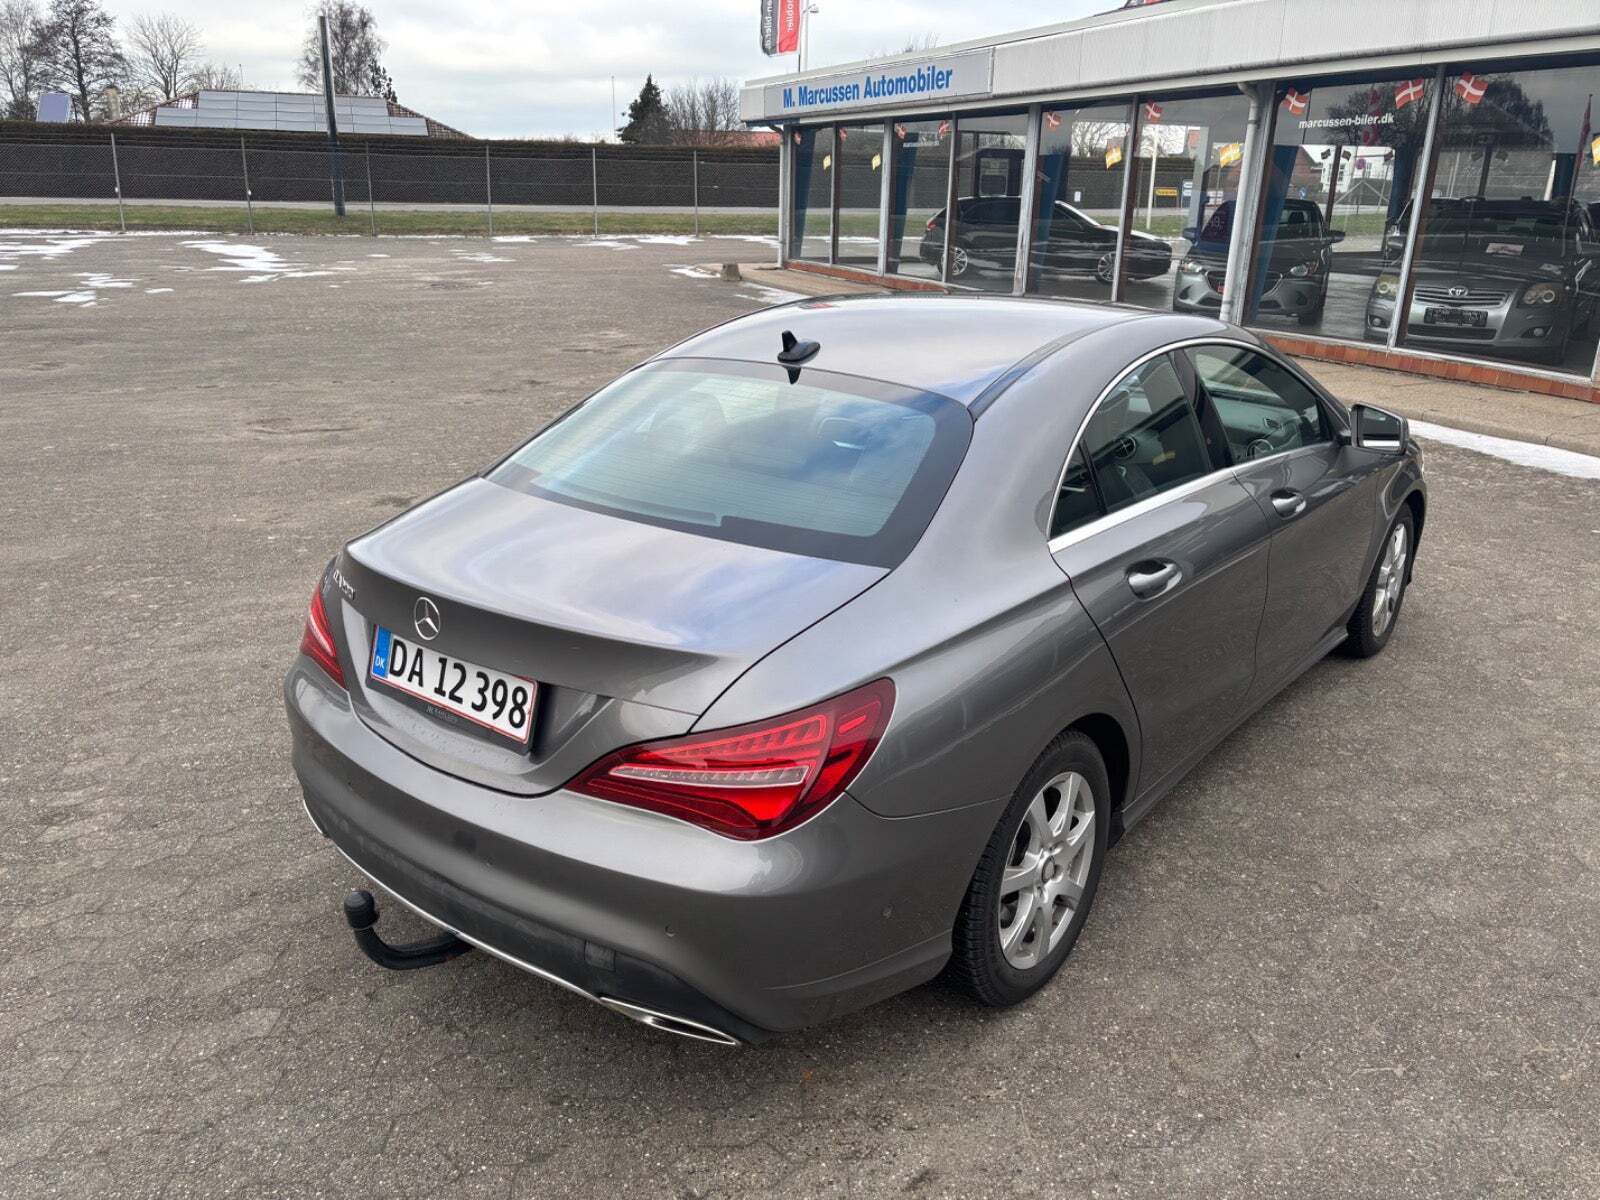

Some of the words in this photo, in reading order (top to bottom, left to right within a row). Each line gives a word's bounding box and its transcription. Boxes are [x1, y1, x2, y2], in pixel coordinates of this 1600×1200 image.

[784, 89, 795, 108] M.
[799, 84, 859, 106] Marcussen
[864, 66, 953, 98] Automobiler
[1299, 113, 1394, 128] marcussen-biler.dk
[374, 655, 386, 669] DK
[389, 638, 424, 688] DA
[434, 656, 467, 705] 12
[471, 670, 529, 729] 398
